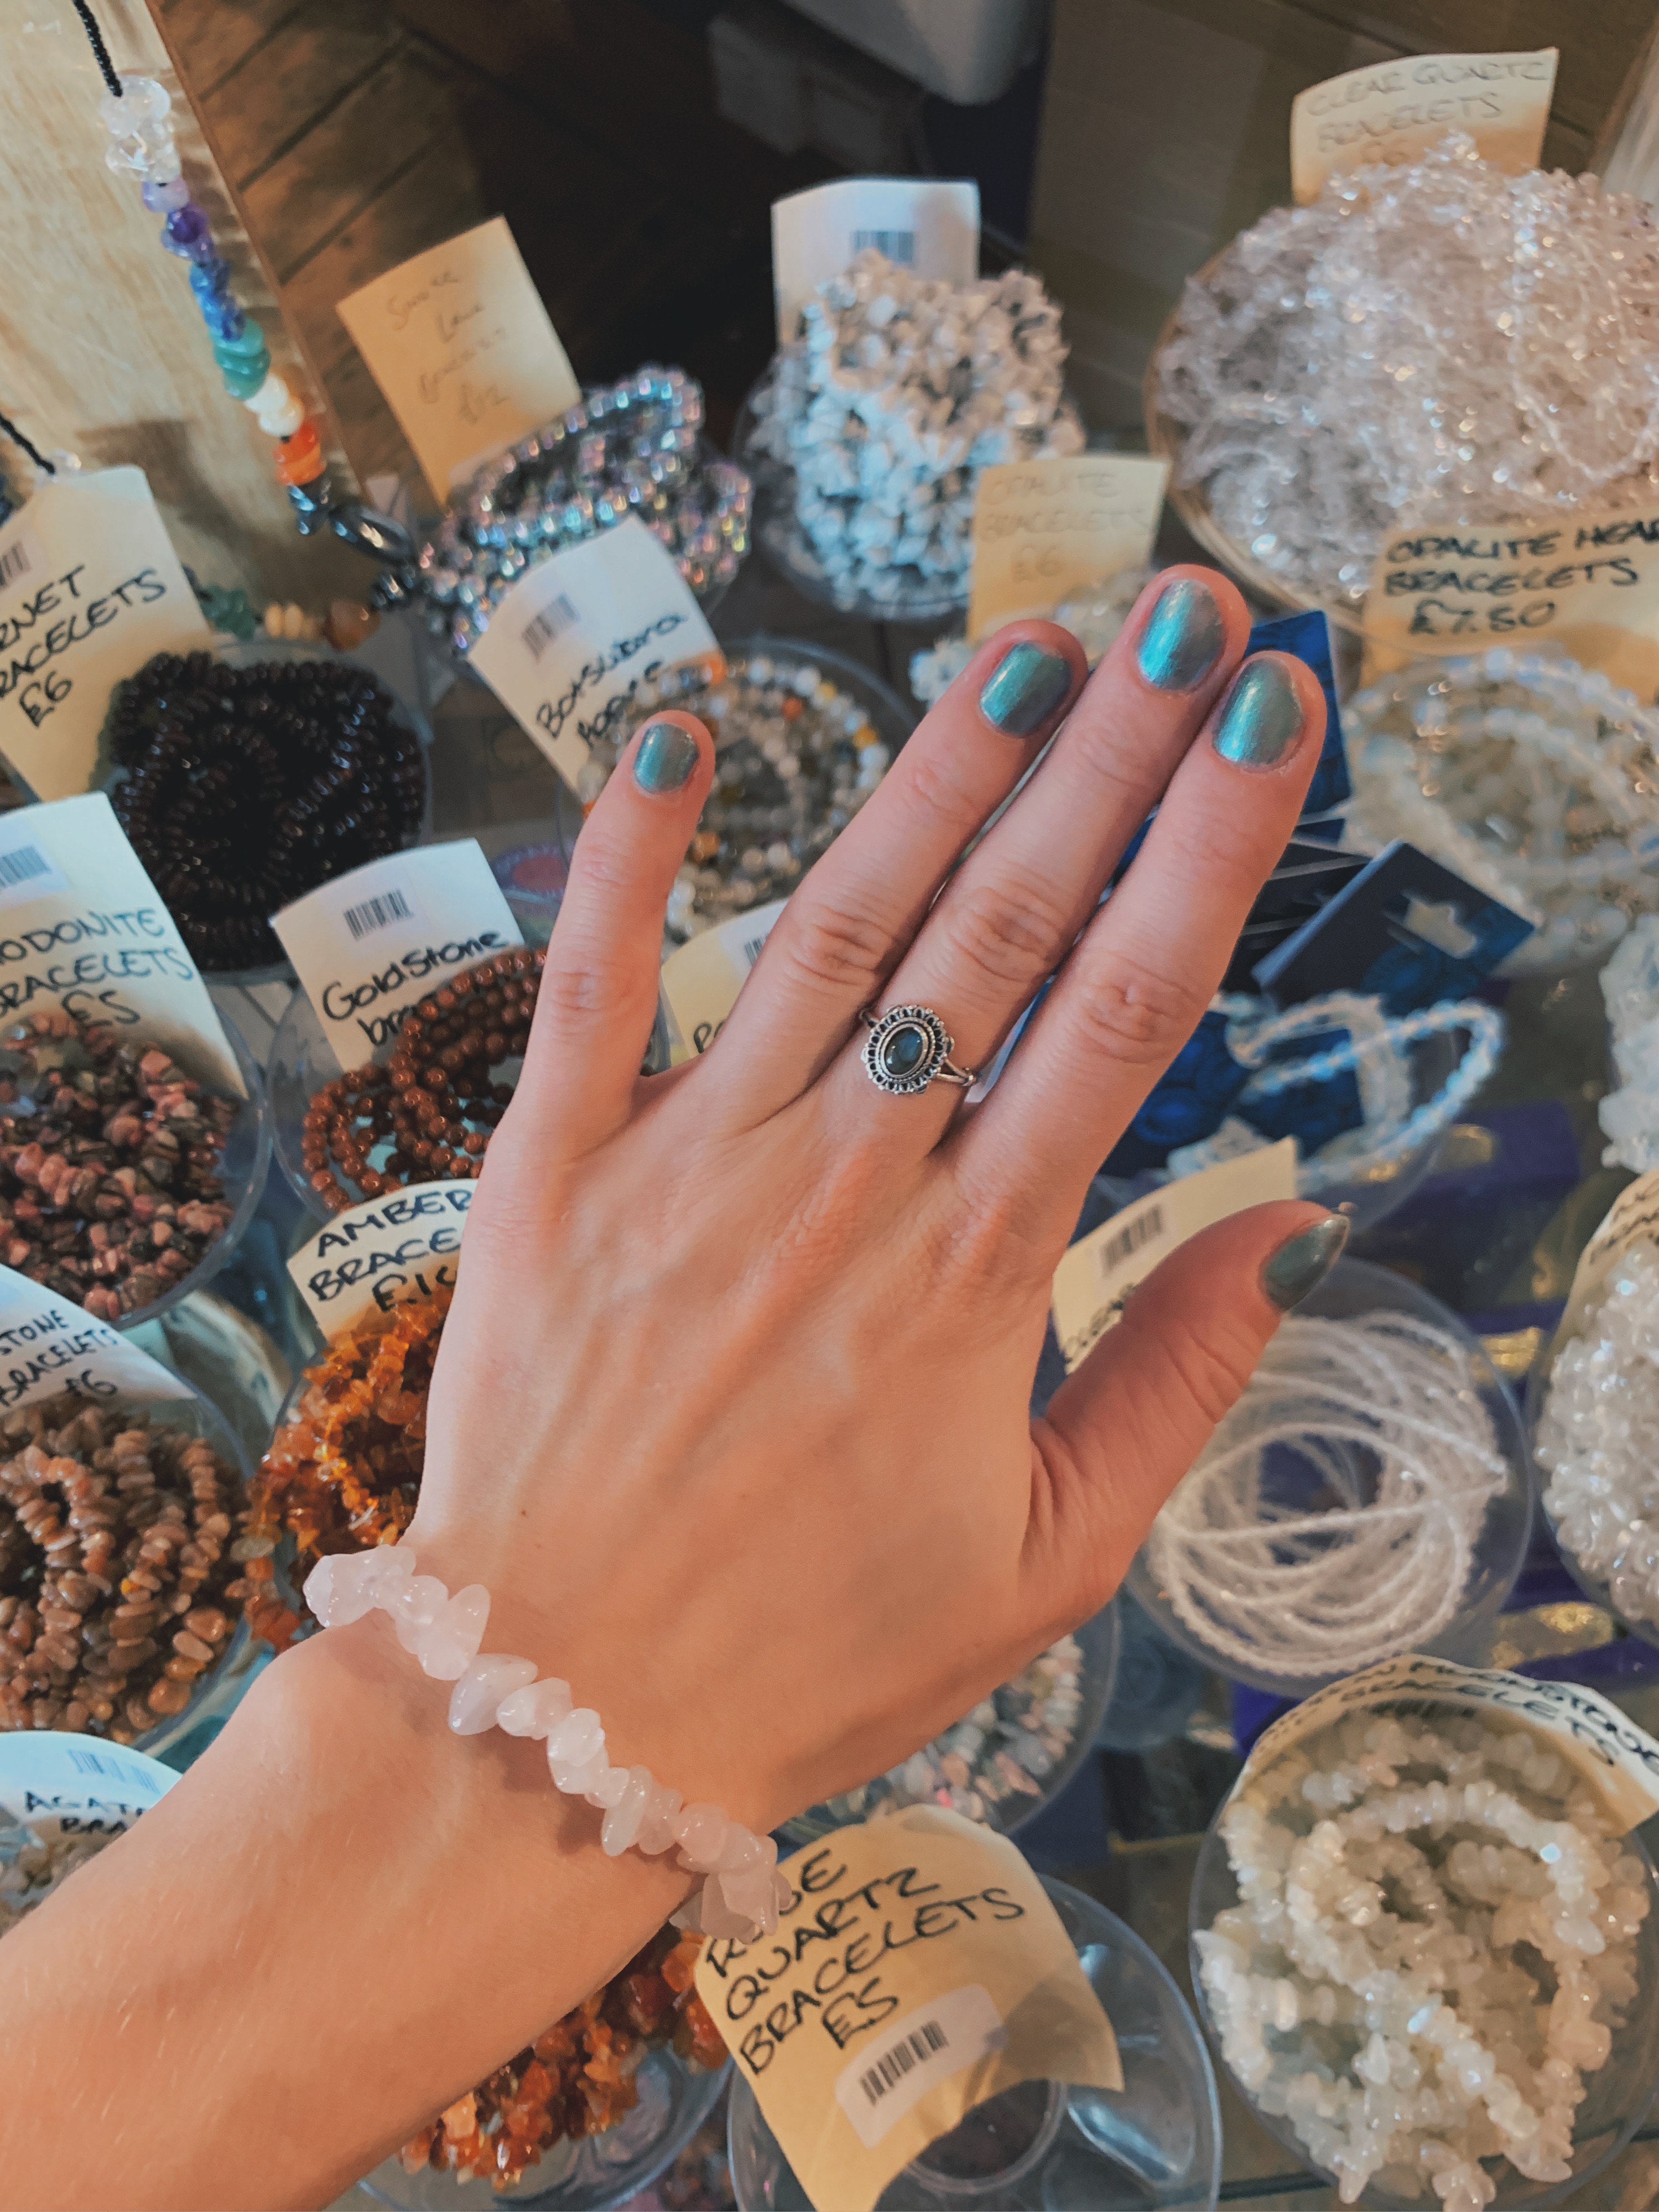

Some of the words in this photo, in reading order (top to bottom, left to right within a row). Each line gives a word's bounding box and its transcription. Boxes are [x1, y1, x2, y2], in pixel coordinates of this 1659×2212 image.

[1385, 556, 1639, 596] BRACELETS
[19, 669, 72, 727] £6
[727, 1867, 939, 2020] QUARTZ
[740, 1888, 1025, 2075] BRACELETS
